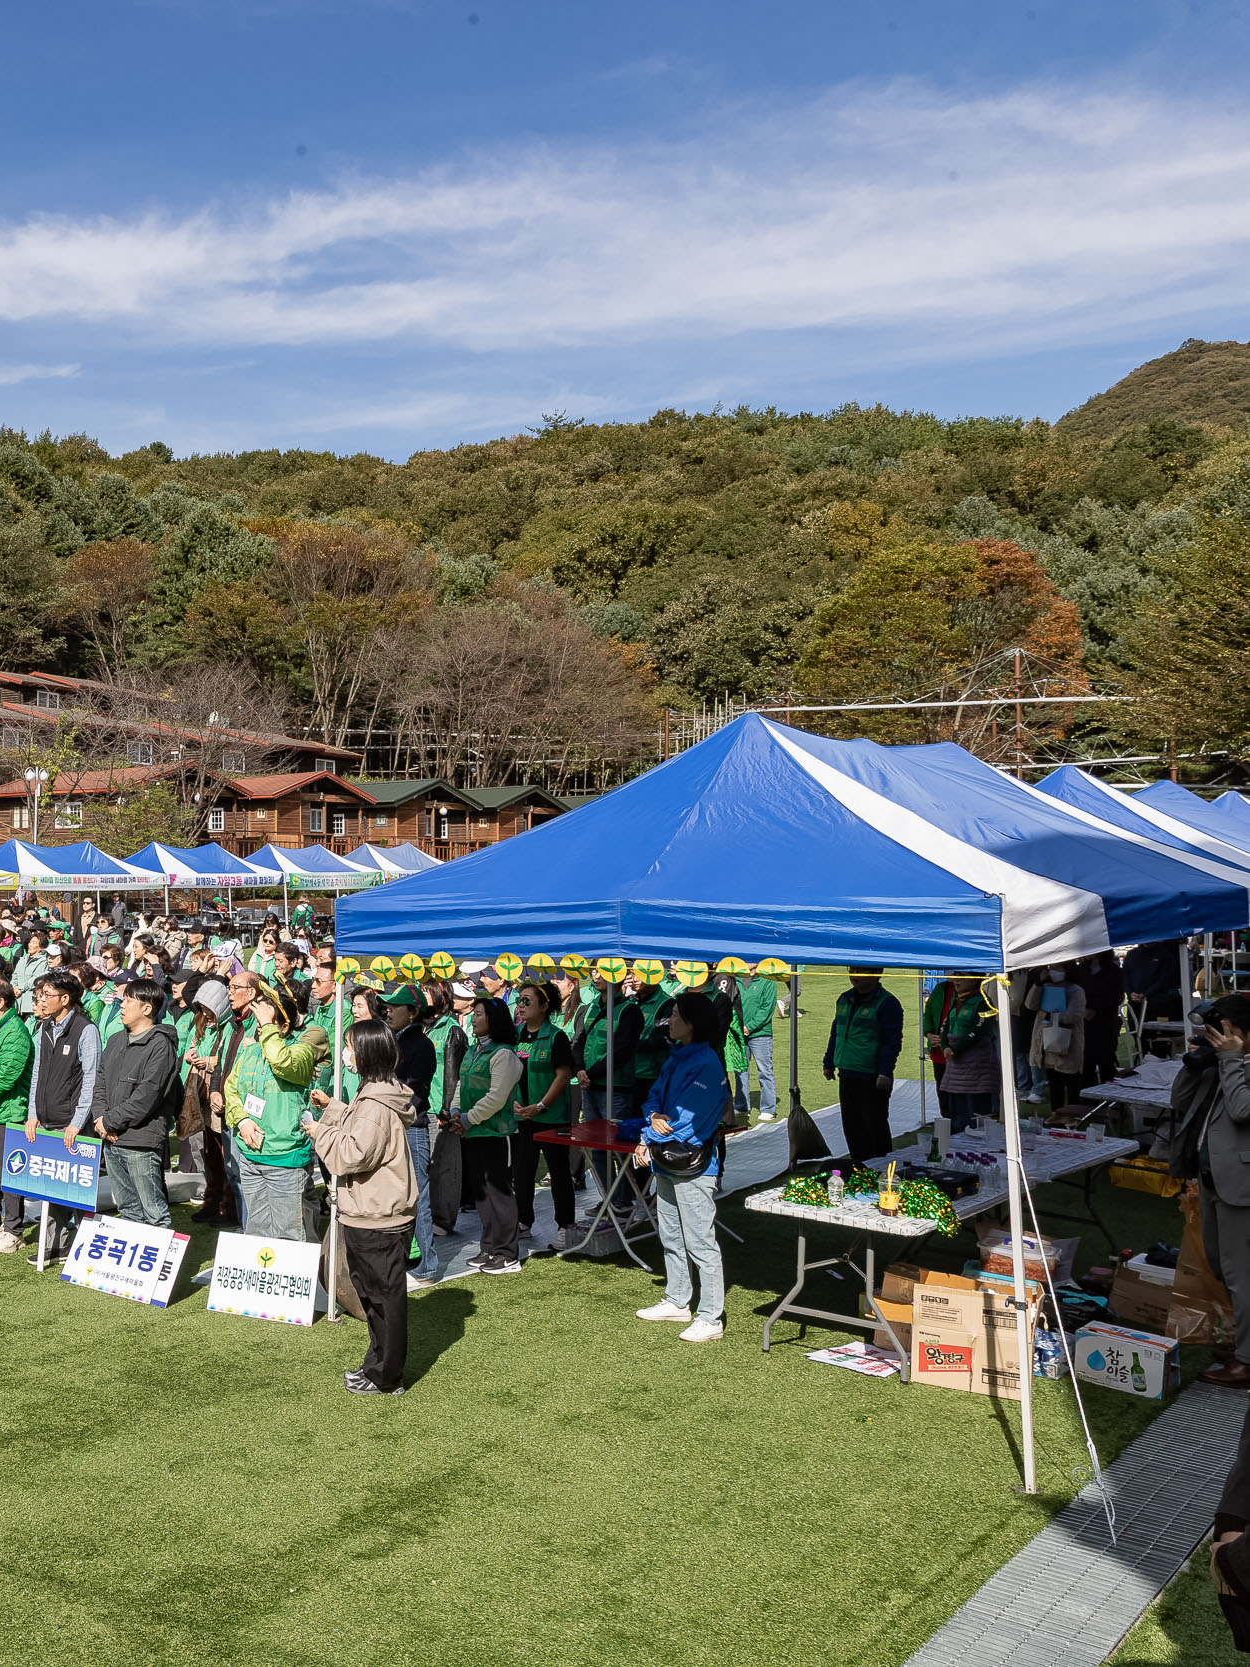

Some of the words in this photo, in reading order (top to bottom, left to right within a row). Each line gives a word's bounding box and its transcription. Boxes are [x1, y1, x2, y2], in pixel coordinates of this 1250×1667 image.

[217, 875, 243, 887] 자양3동
[29, 1155, 94, 1187] 중곡제1동
[88, 1234, 159, 1272] 중곡1동
[217, 1265, 312, 1300] 직장공장새마을광진구협의회
[1105, 1347, 1124, 1366] 참
[1106, 1366, 1130, 1384] 이슬
